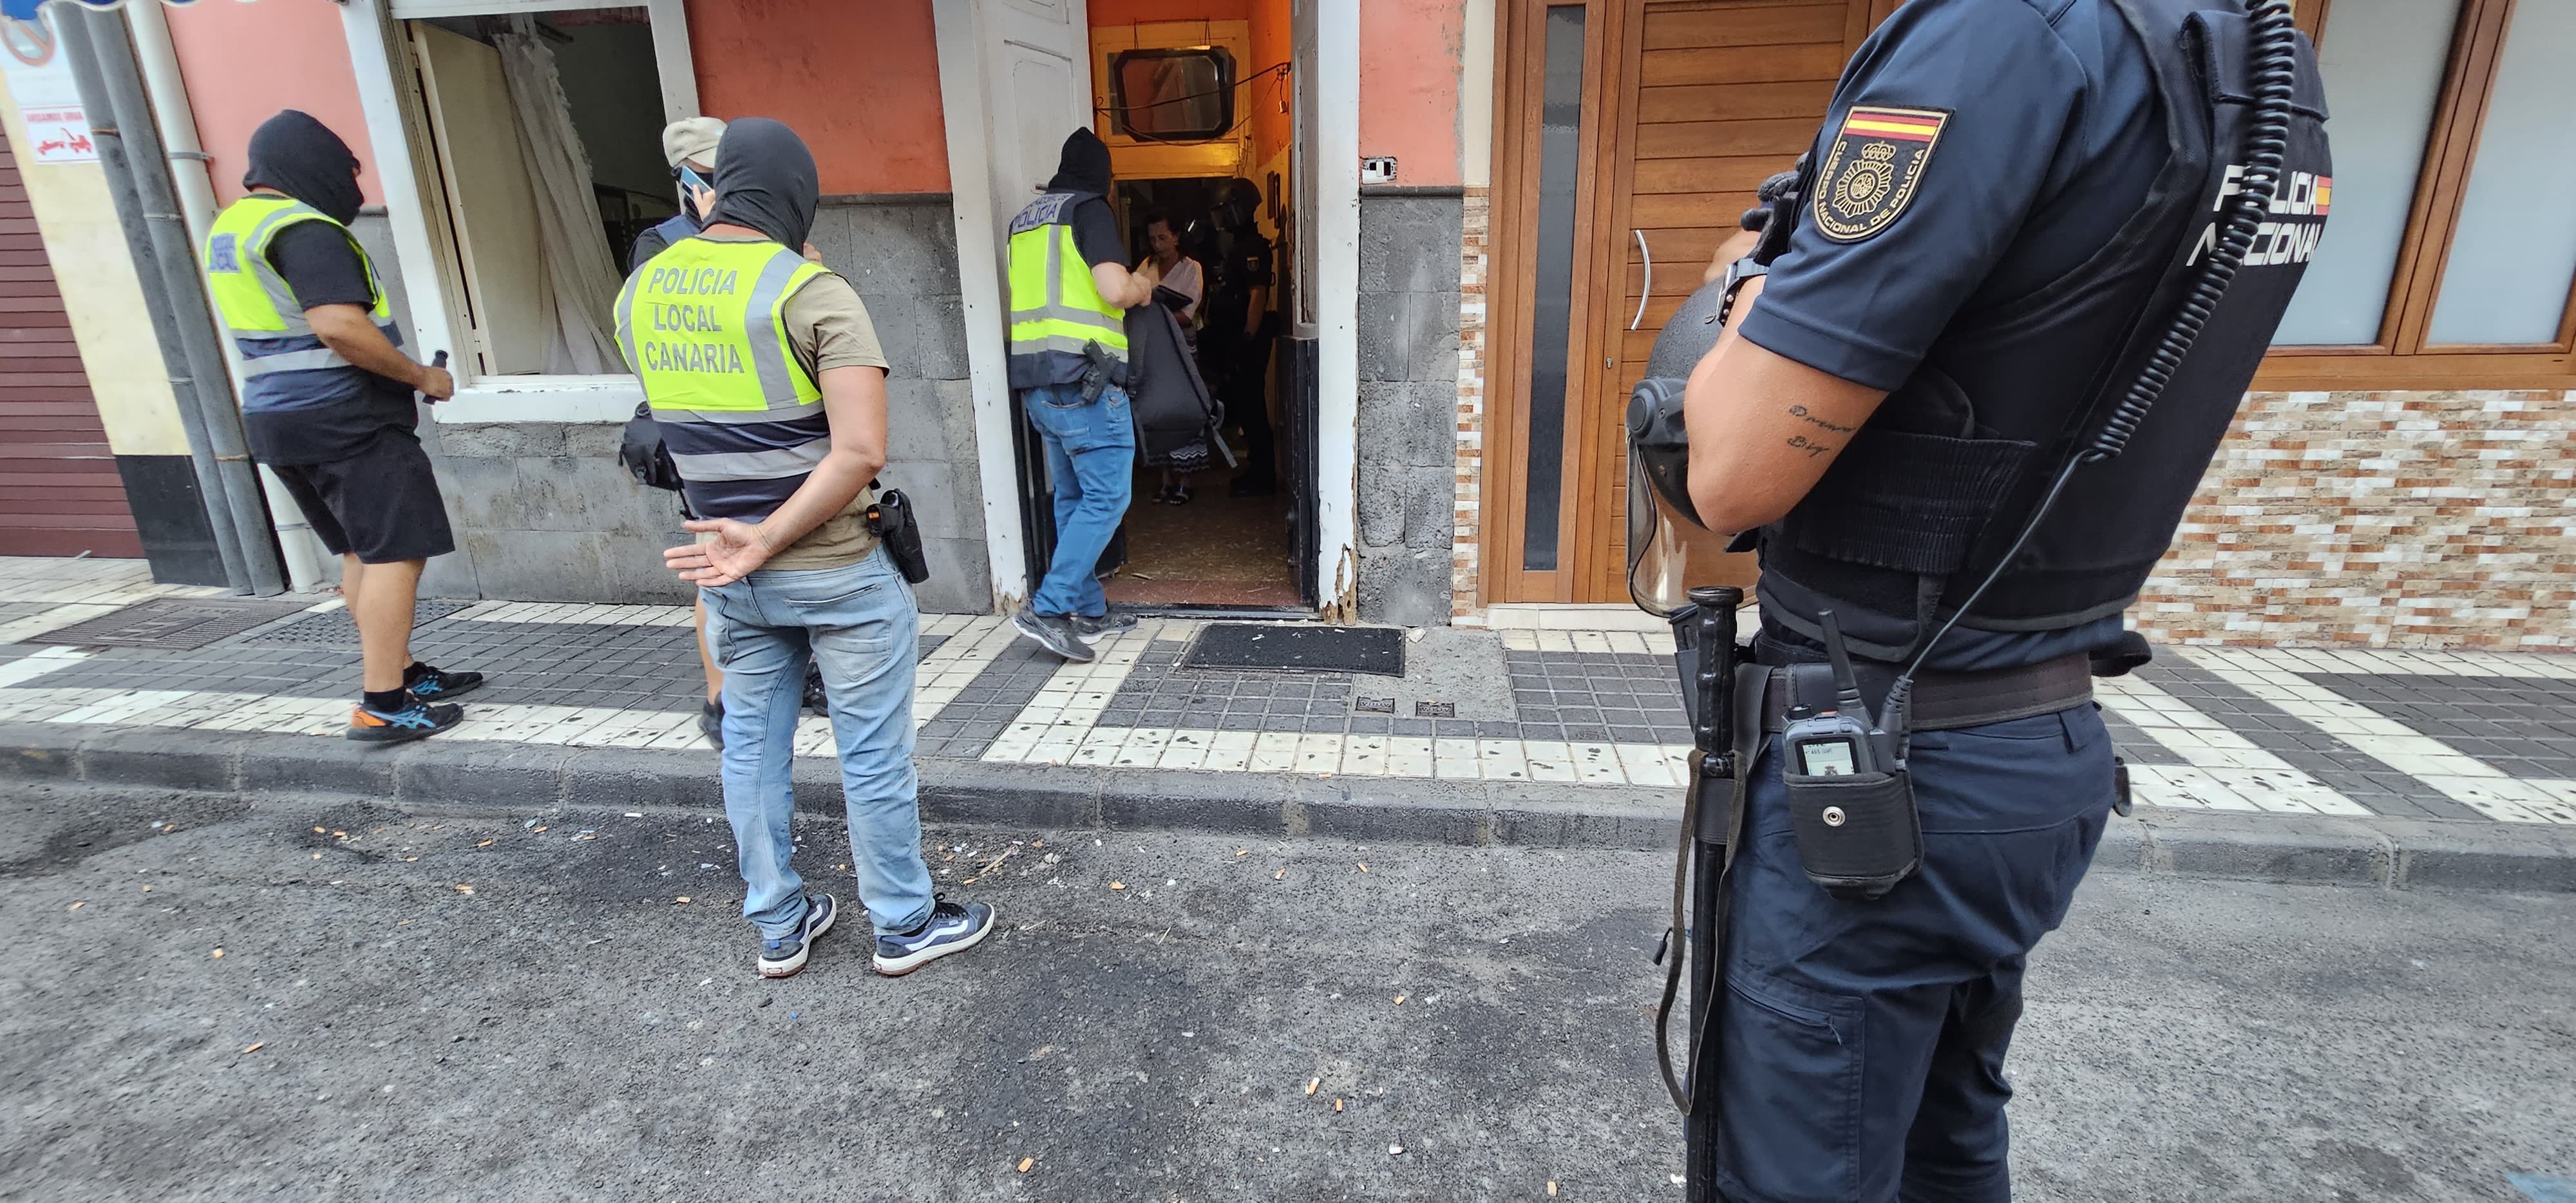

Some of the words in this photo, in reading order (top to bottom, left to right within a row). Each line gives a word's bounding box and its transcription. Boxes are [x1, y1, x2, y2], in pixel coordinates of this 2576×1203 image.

[1819, 141, 1848, 200] CUERPO
[1891, 149, 1925, 209] POLICIA
[2213, 164, 2318, 215] PLICIA
[1819, 201, 1866, 233] NACIONAL
[1870, 209, 1891, 226] DE
[2186, 222, 2321, 267] NCIONAL
[647, 267, 737, 295] POLICIA
[653, 304, 722, 332] LOCAL
[645, 341, 744, 374] CANARIA
